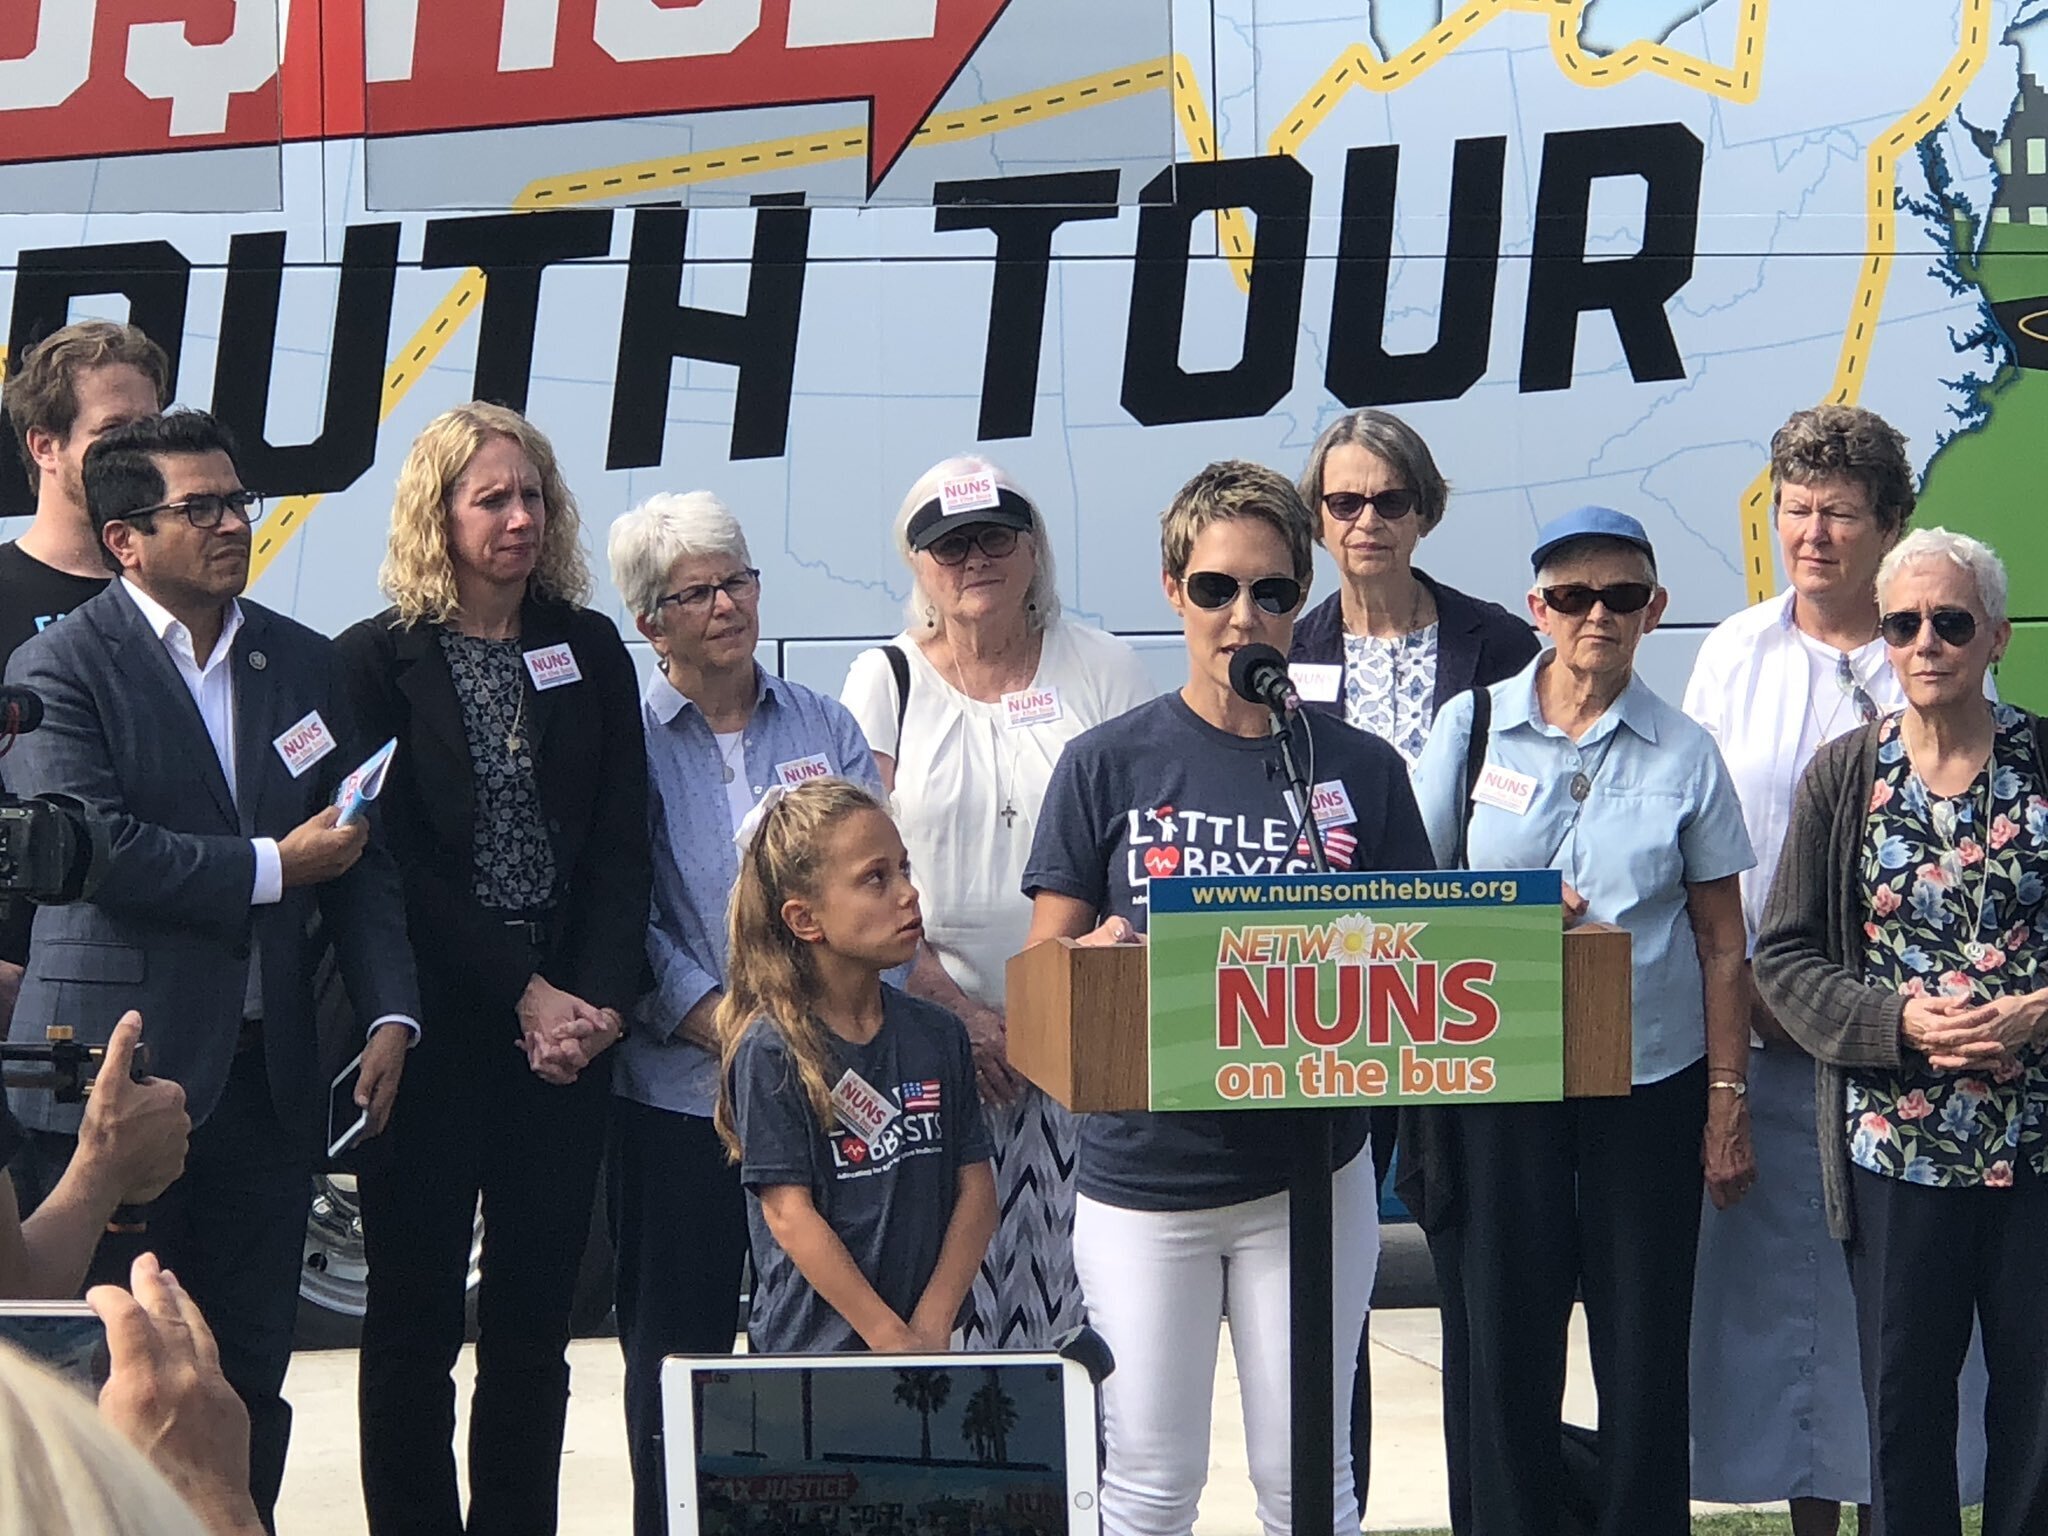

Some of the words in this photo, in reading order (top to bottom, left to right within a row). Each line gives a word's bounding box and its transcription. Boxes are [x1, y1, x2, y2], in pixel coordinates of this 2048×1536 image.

[933, 121, 1705, 443] TOUR
[944, 479, 991, 498] NUNS
[531, 652, 571, 672] NUNS
[1008, 692, 1053, 712] NUNS
[283, 721, 322, 758] NUNS
[784, 762, 827, 783] NUNS
[1485, 772, 1529, 796] NUNS
[1311, 791, 1343, 809] UNS
[1191, 878, 1517, 904] www.nunsonthebus.org
[1218, 912, 1428, 965] NETWORK
[1216, 961, 1500, 1049] NUNS
[1215, 1063, 1286, 1100] on
[1297, 1047, 1388, 1098] the
[1399, 1046, 1496, 1095] bus
[840, 1081, 886, 1125] NUNS
